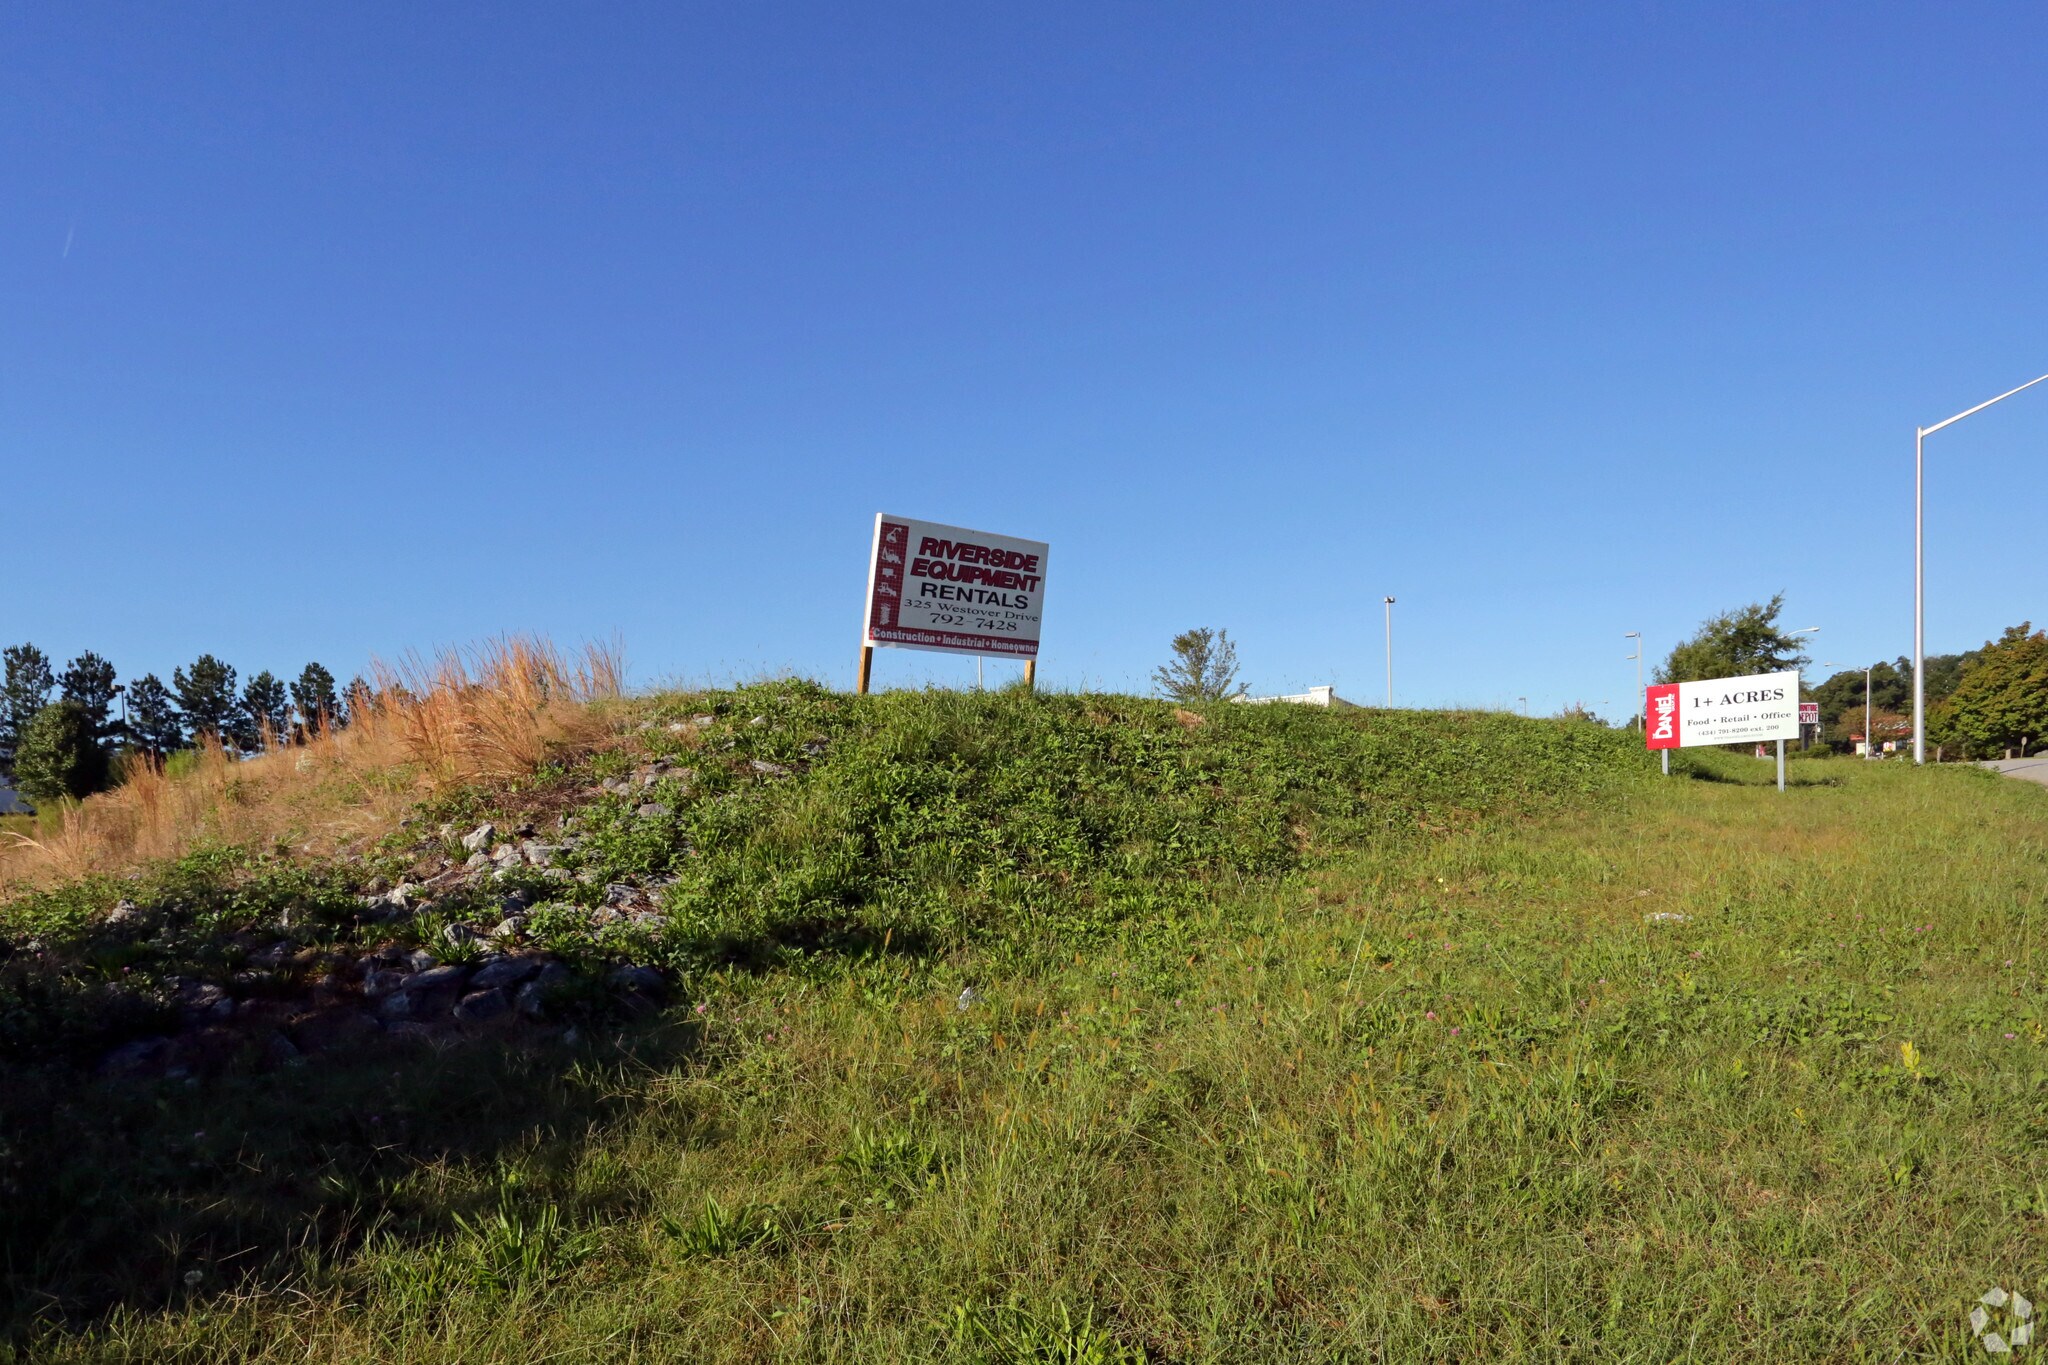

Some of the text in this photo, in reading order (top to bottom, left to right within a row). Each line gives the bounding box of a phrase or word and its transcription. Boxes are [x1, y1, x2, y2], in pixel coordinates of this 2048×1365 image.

[919, 537, 1039, 573] RIVERSIDE
[910, 558, 1041, 592] EQUIPMENT
[921, 582, 1028, 609] RENTALS
[904, 599, 1038, 622] 325 Westover Drive
[930, 613, 1017, 632] 792-7428
[873, 627, 935, 643] Construction
[943, 636, 984, 648] Industrial
[1694, 688, 1785, 708] 1+ ACRES
[1687, 711, 1791, 727] Food Retail Office
[1698, 729, 1716, 737] (434)
